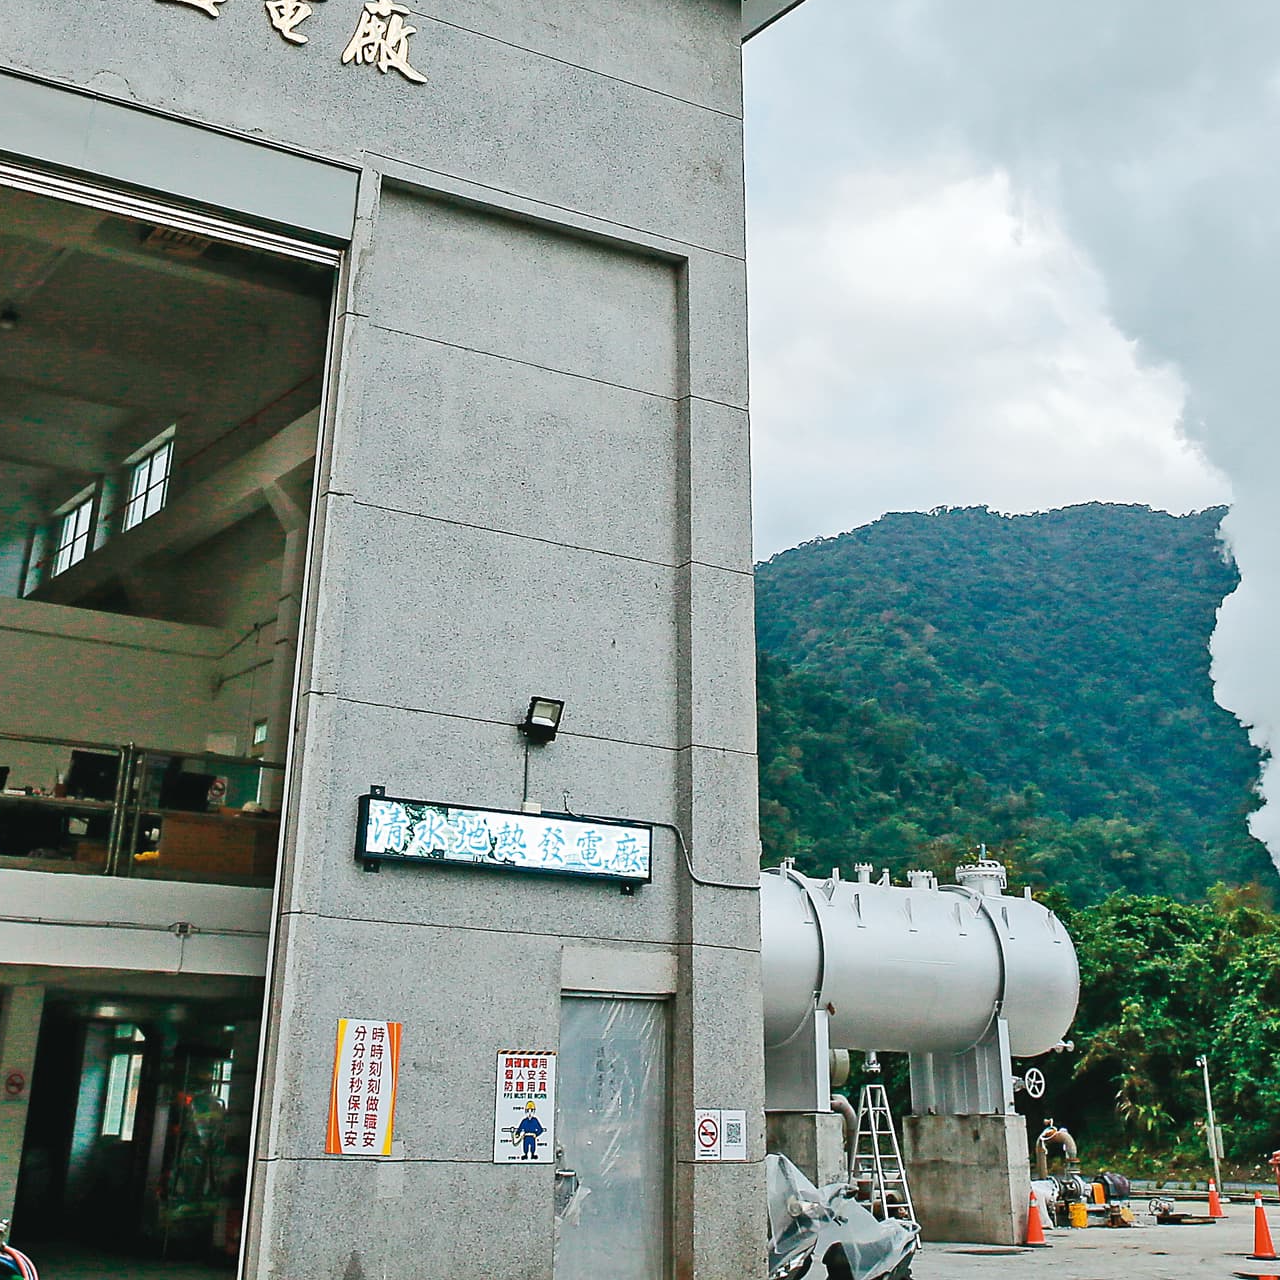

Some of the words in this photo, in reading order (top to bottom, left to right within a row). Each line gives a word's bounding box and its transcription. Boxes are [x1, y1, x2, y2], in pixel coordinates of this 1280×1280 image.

[373, 808, 643, 871] 清水地熱發電廠
[344, 1025, 367, 1147] 分分秒秒保平安
[362, 1027, 385, 1148] 時時刻刻做職安
